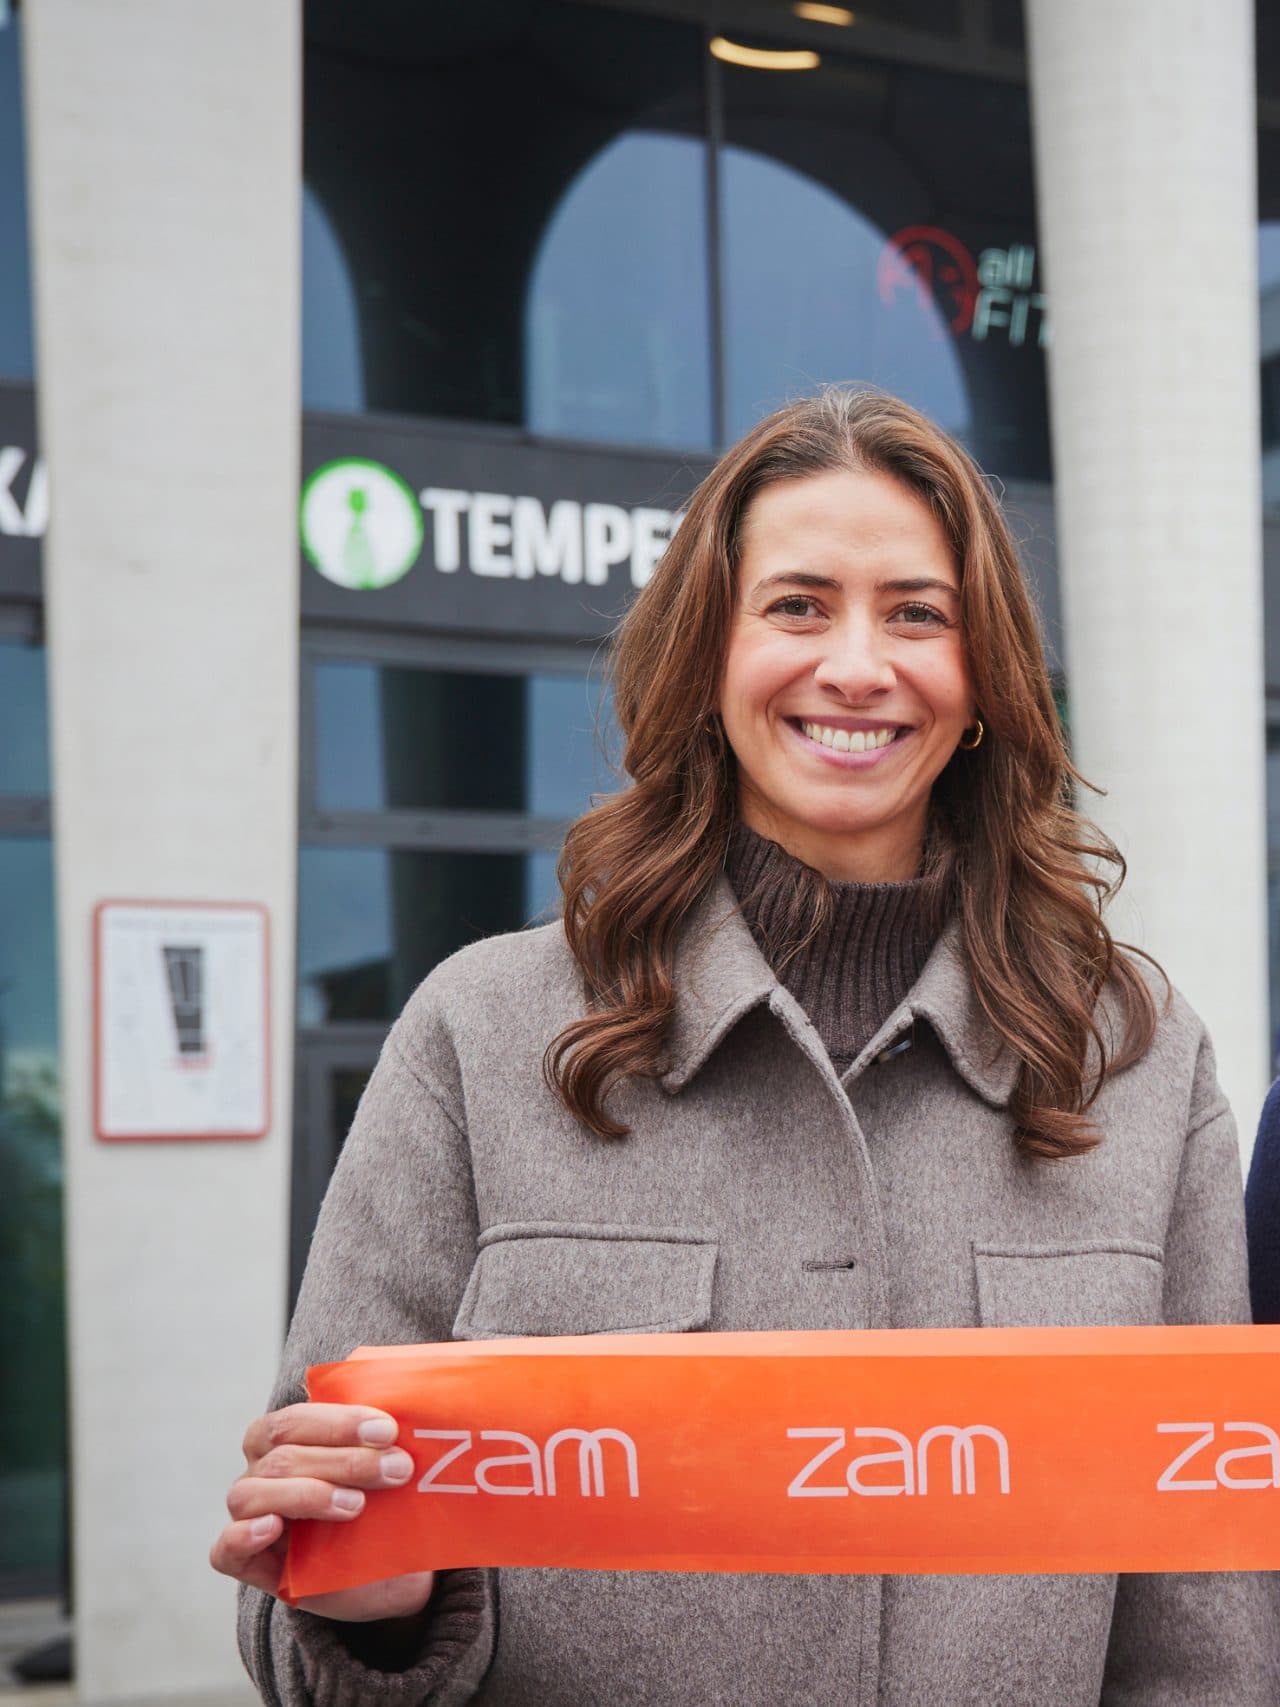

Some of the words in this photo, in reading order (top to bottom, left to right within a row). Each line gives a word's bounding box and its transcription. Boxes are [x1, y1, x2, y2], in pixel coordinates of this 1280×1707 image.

[977, 244, 1035, 290] all
[420, 486, 685, 588] TEMPE
[413, 1428, 639, 1497] zam
[787, 1425, 1010, 1497] zam
